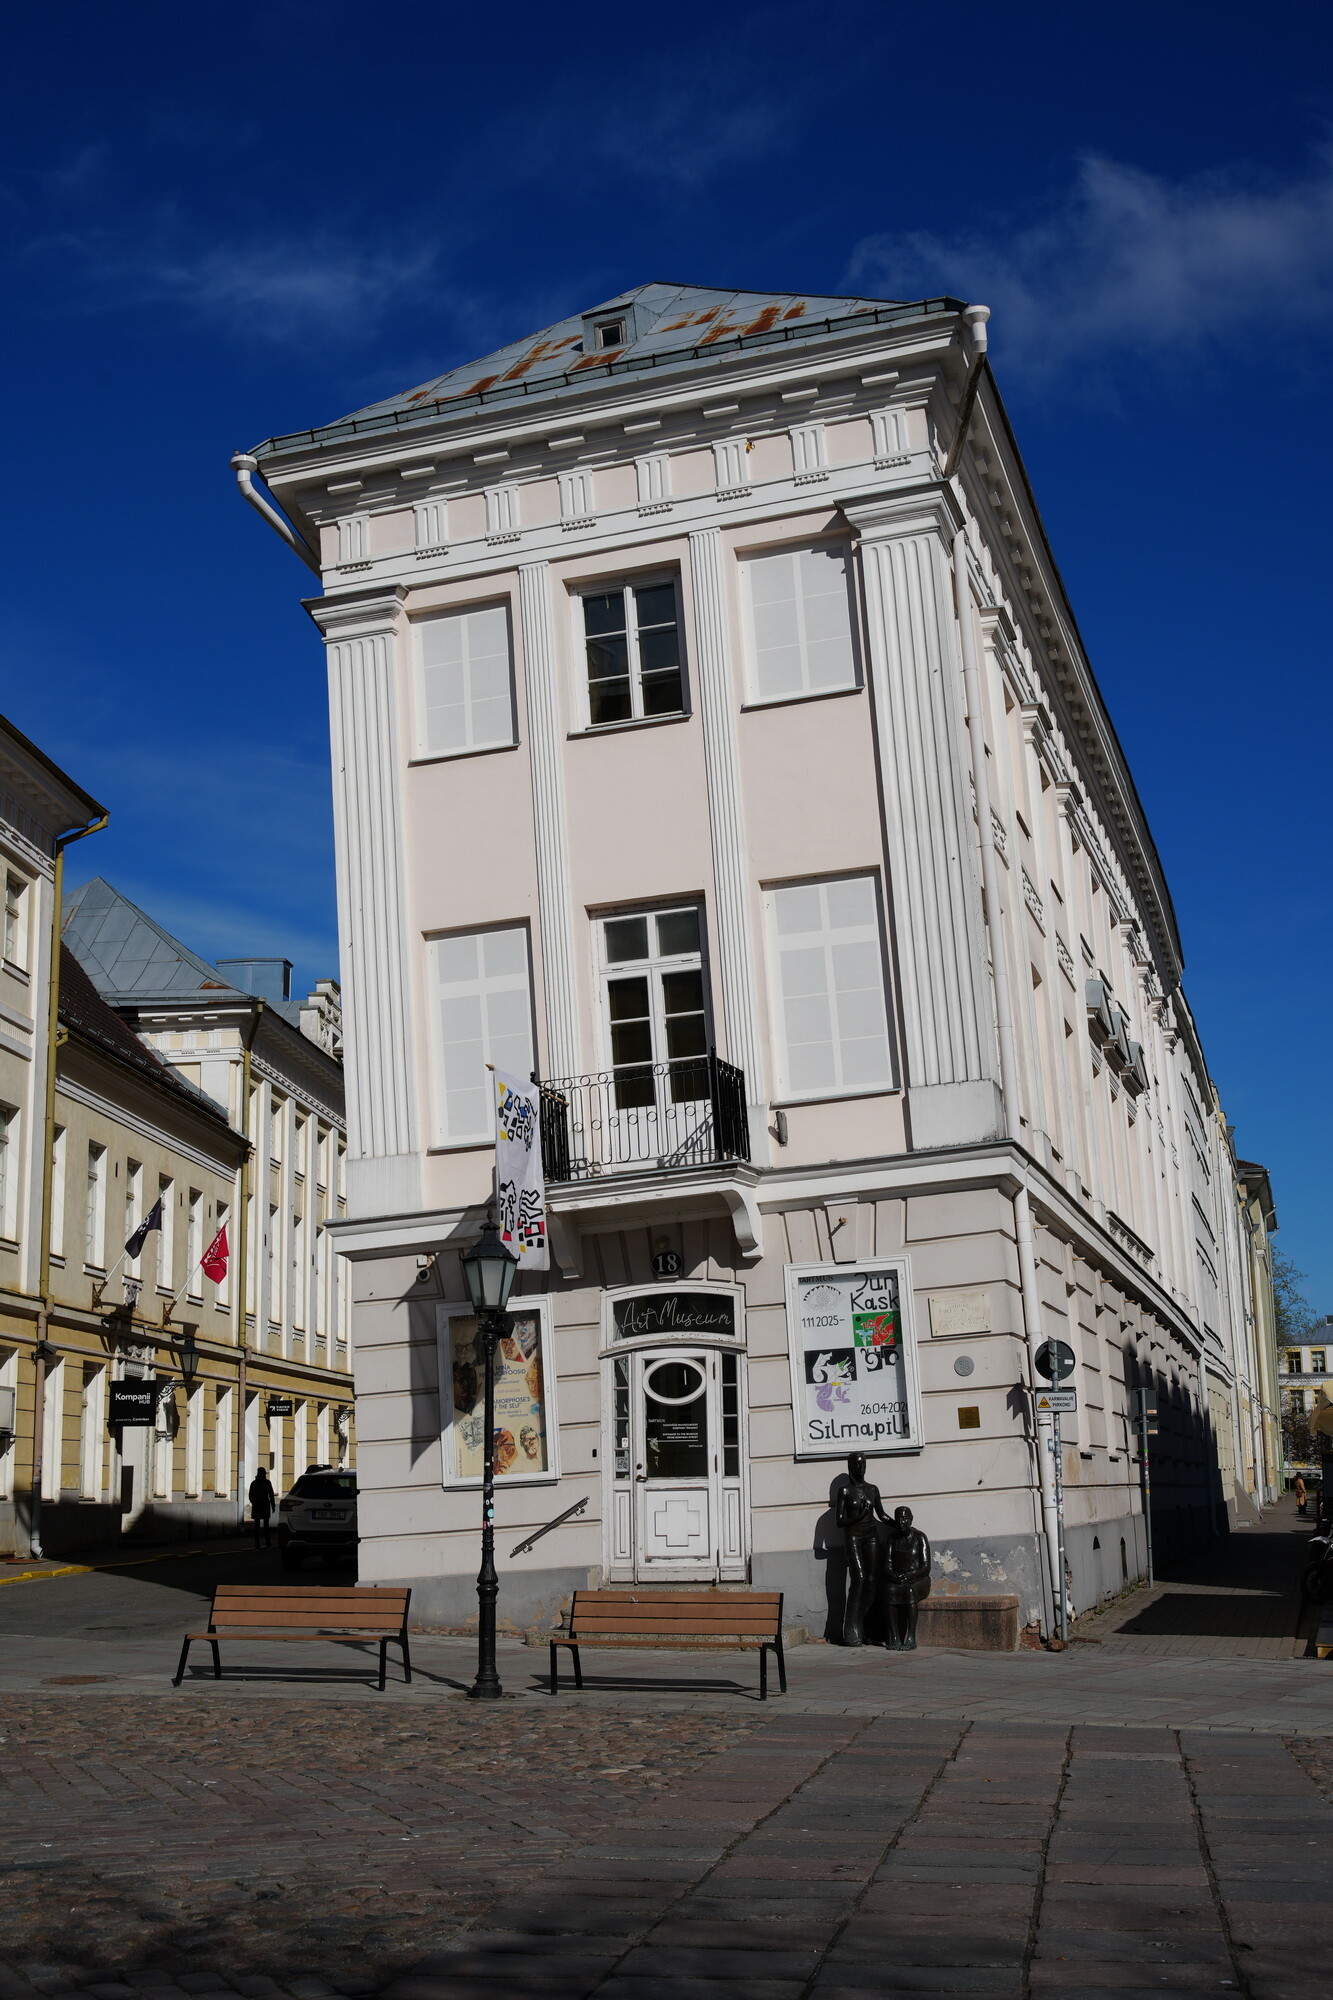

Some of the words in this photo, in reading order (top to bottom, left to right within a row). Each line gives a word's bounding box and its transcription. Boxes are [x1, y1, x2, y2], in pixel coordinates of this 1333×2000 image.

[656, 1254, 678, 1272] 18
[798, 1275, 834, 1283] TARTMUS
[850, 1289, 900, 1312] Kask
[621, 1301, 658, 1333] Art
[659, 1297, 732, 1327] Museum
[115, 1392, 151, 1402] Kompanii
[808, 1413, 910, 1441] Silmapilk
